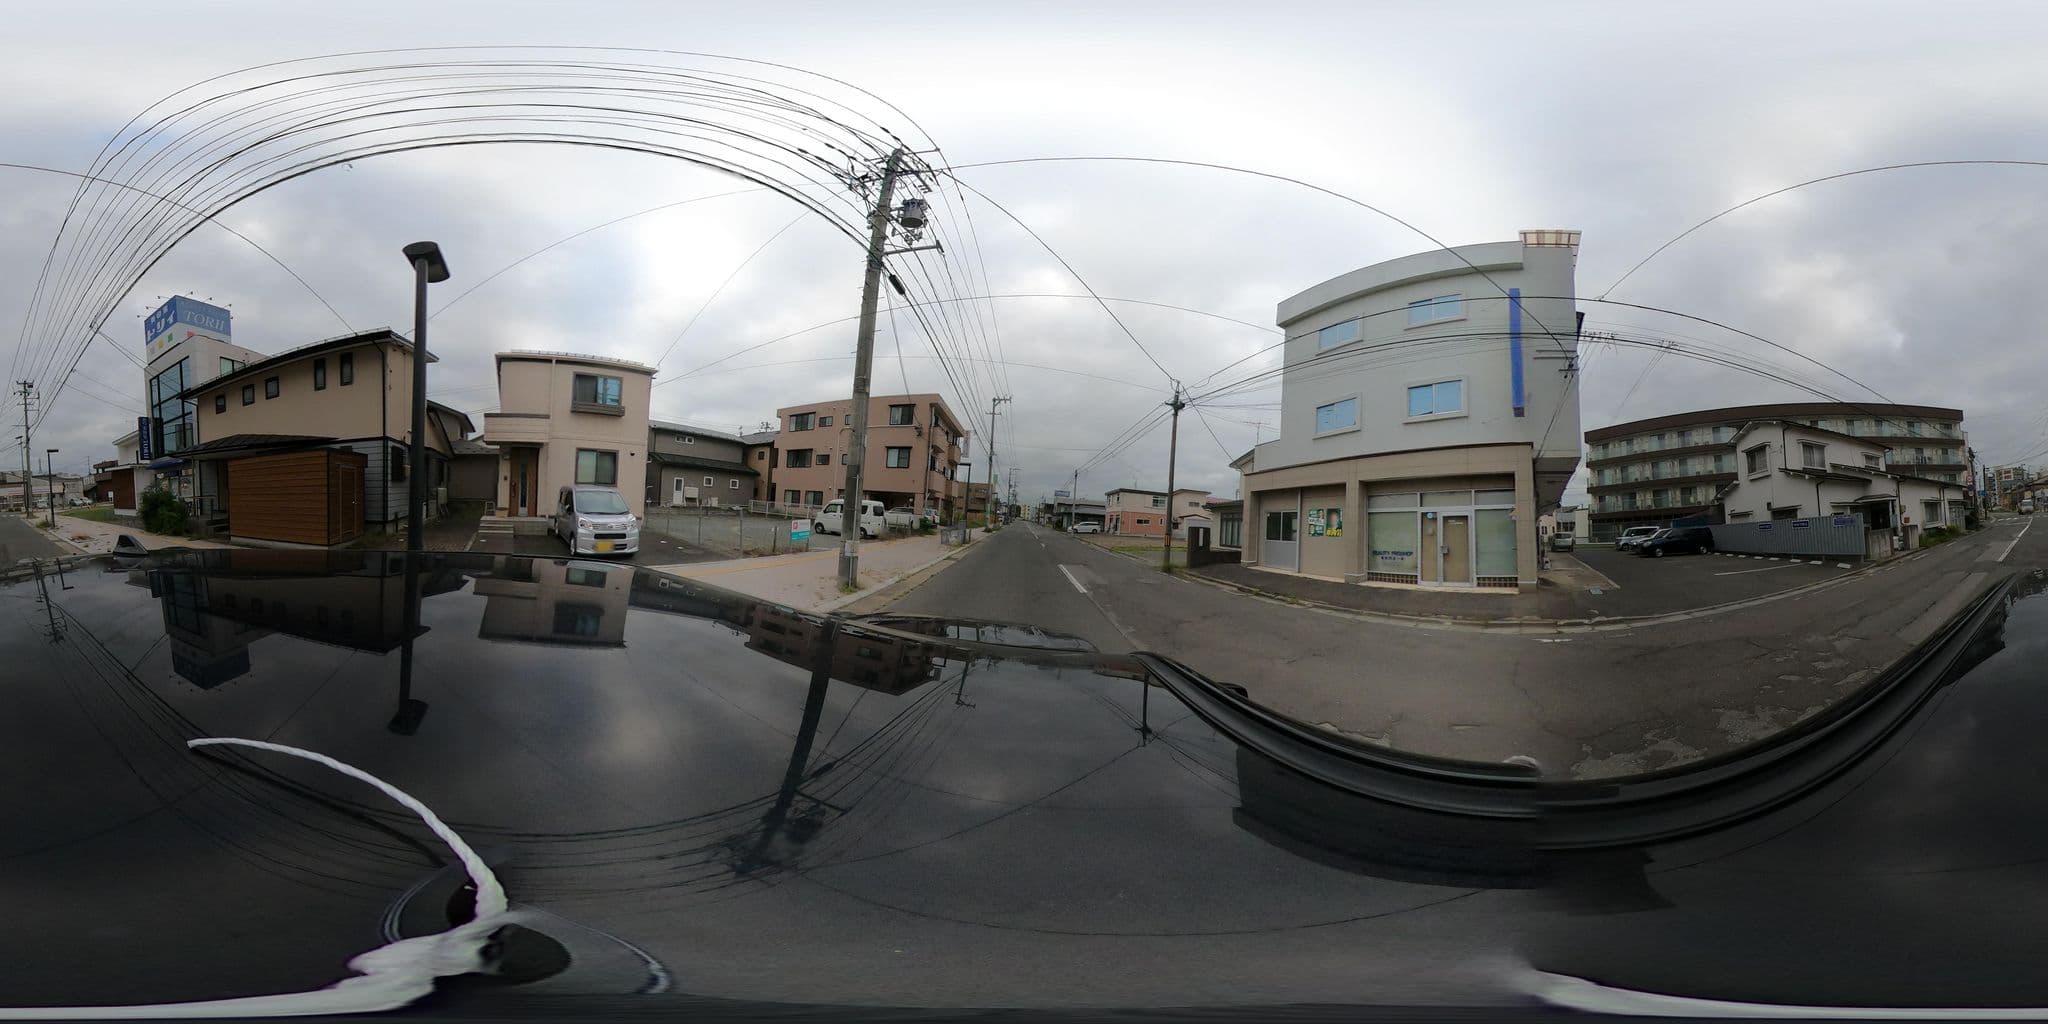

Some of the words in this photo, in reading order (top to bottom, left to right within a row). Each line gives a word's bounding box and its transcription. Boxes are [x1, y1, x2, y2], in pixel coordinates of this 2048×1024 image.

[147, 310, 175, 342] トリイ
[184, 310, 225, 331] TORII
